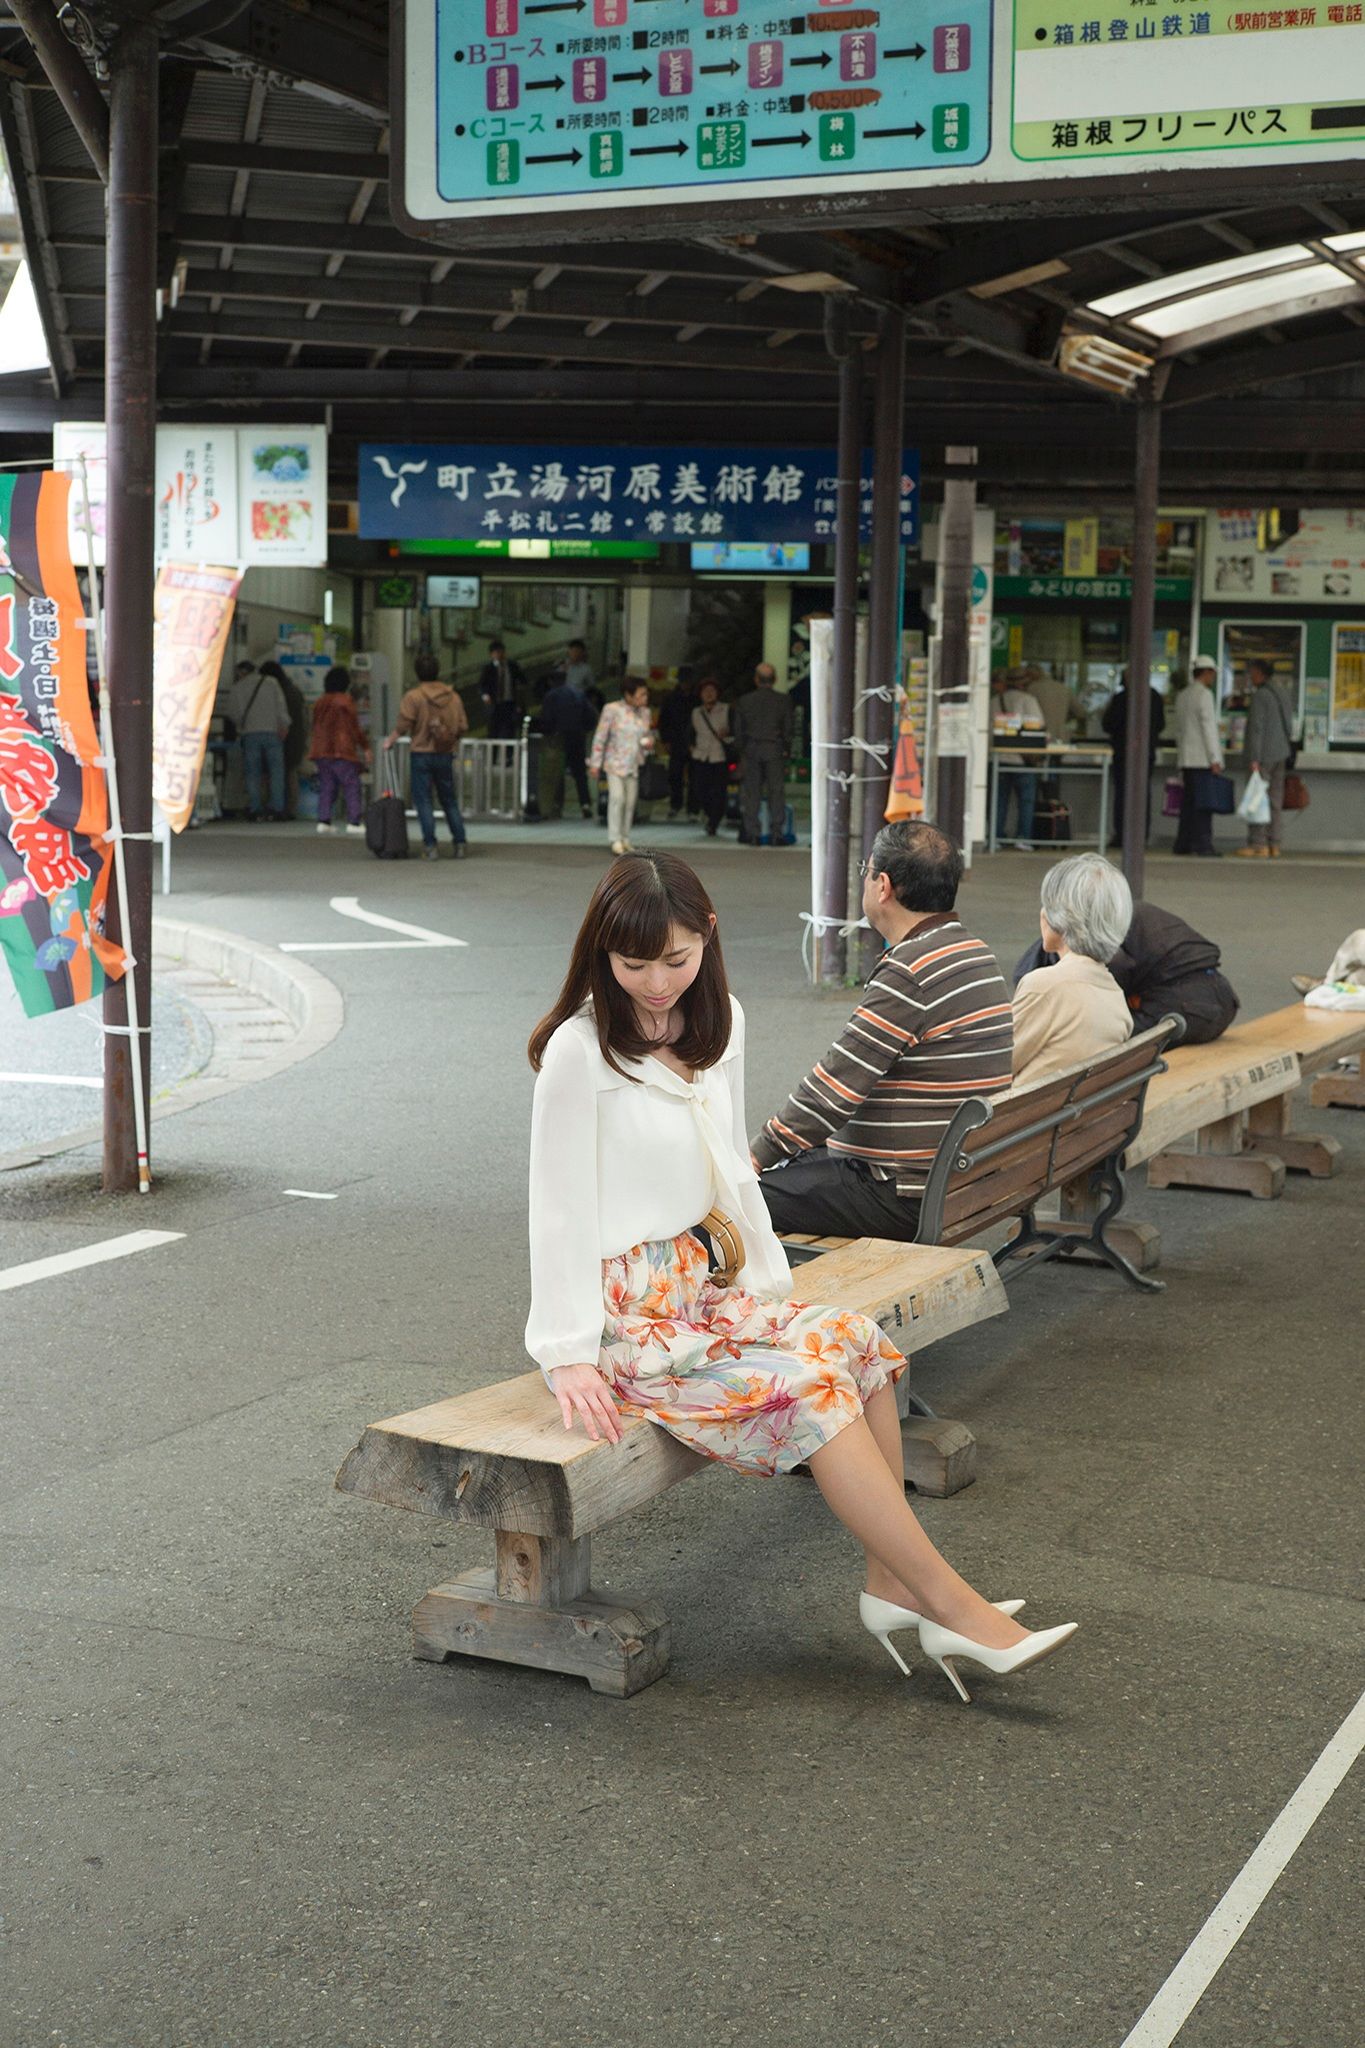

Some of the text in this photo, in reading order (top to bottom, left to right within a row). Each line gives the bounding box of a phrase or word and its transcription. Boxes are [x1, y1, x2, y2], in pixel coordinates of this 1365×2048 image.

[1053, 12, 1211, 45] 箱根登山鉄道
[1327, 3, 1362, 23] 電話
[467, 37, 545, 65] Bコース
[469, 114, 545, 139] Cコース
[1052, 109, 1287, 149] 箱根フリーパス
[437, 463, 804, 505] 町立湯河原美術館
[1028, 579, 1121, 598] みどりの窓口
